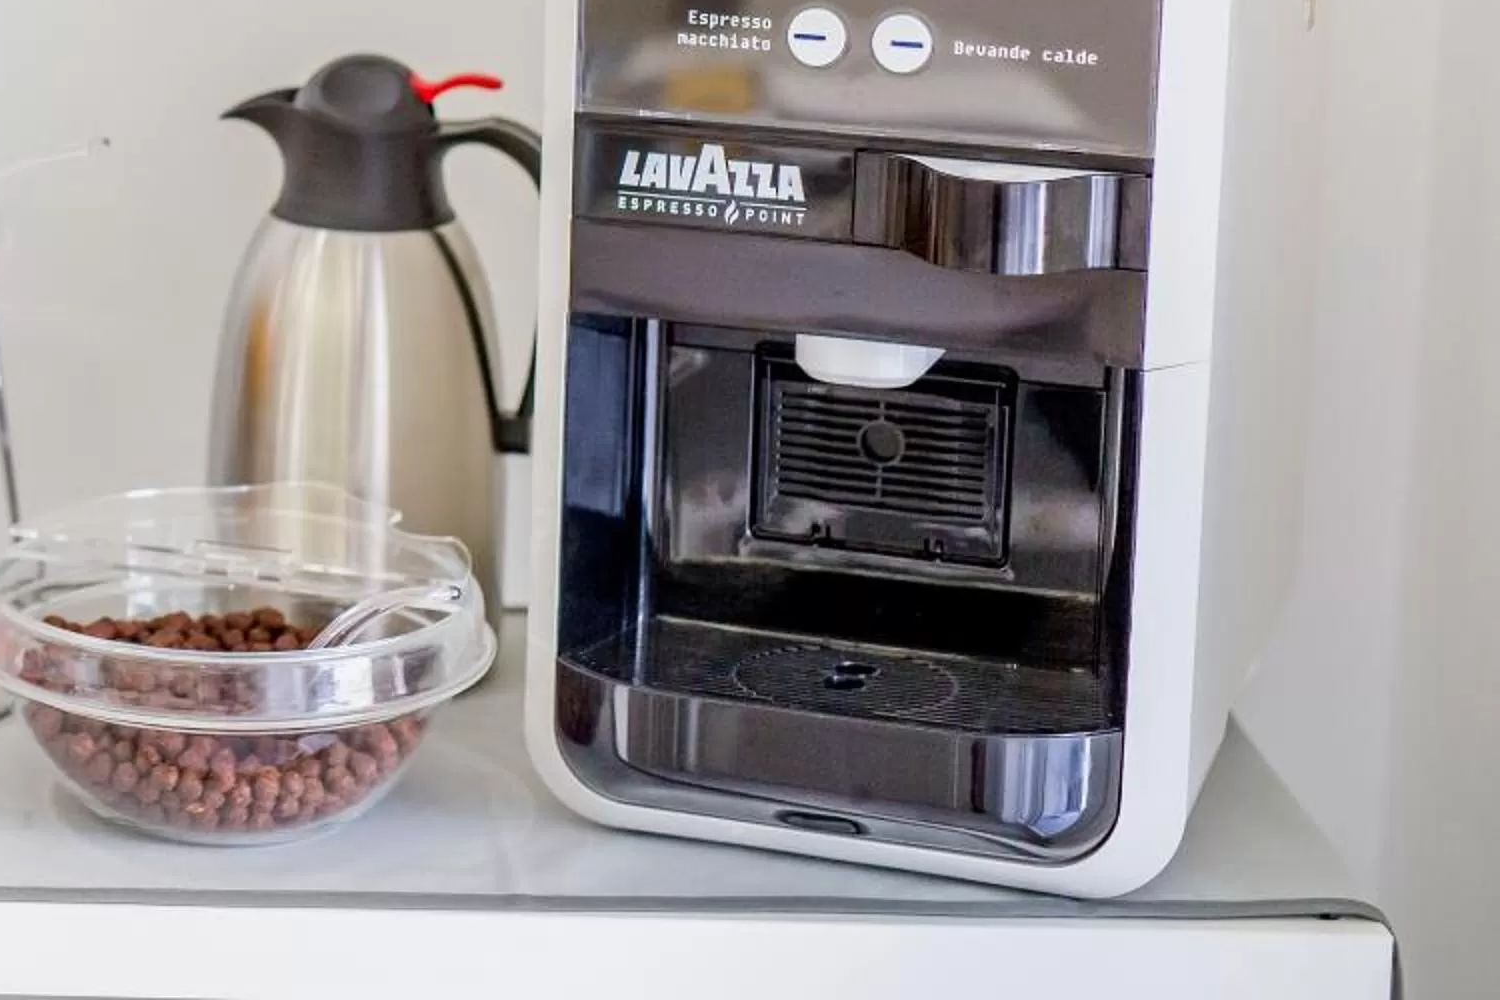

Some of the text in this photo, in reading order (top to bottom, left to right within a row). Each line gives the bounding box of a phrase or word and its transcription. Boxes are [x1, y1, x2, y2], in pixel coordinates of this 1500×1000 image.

[688, 9, 773, 30] Espresso
[677, 31, 772, 51] macchiato
[953, 40, 1100, 66] Bevande calde
[619, 143, 806, 202] LAVAZZA
[617, 196, 805, 226] ESPRESSO POINT
